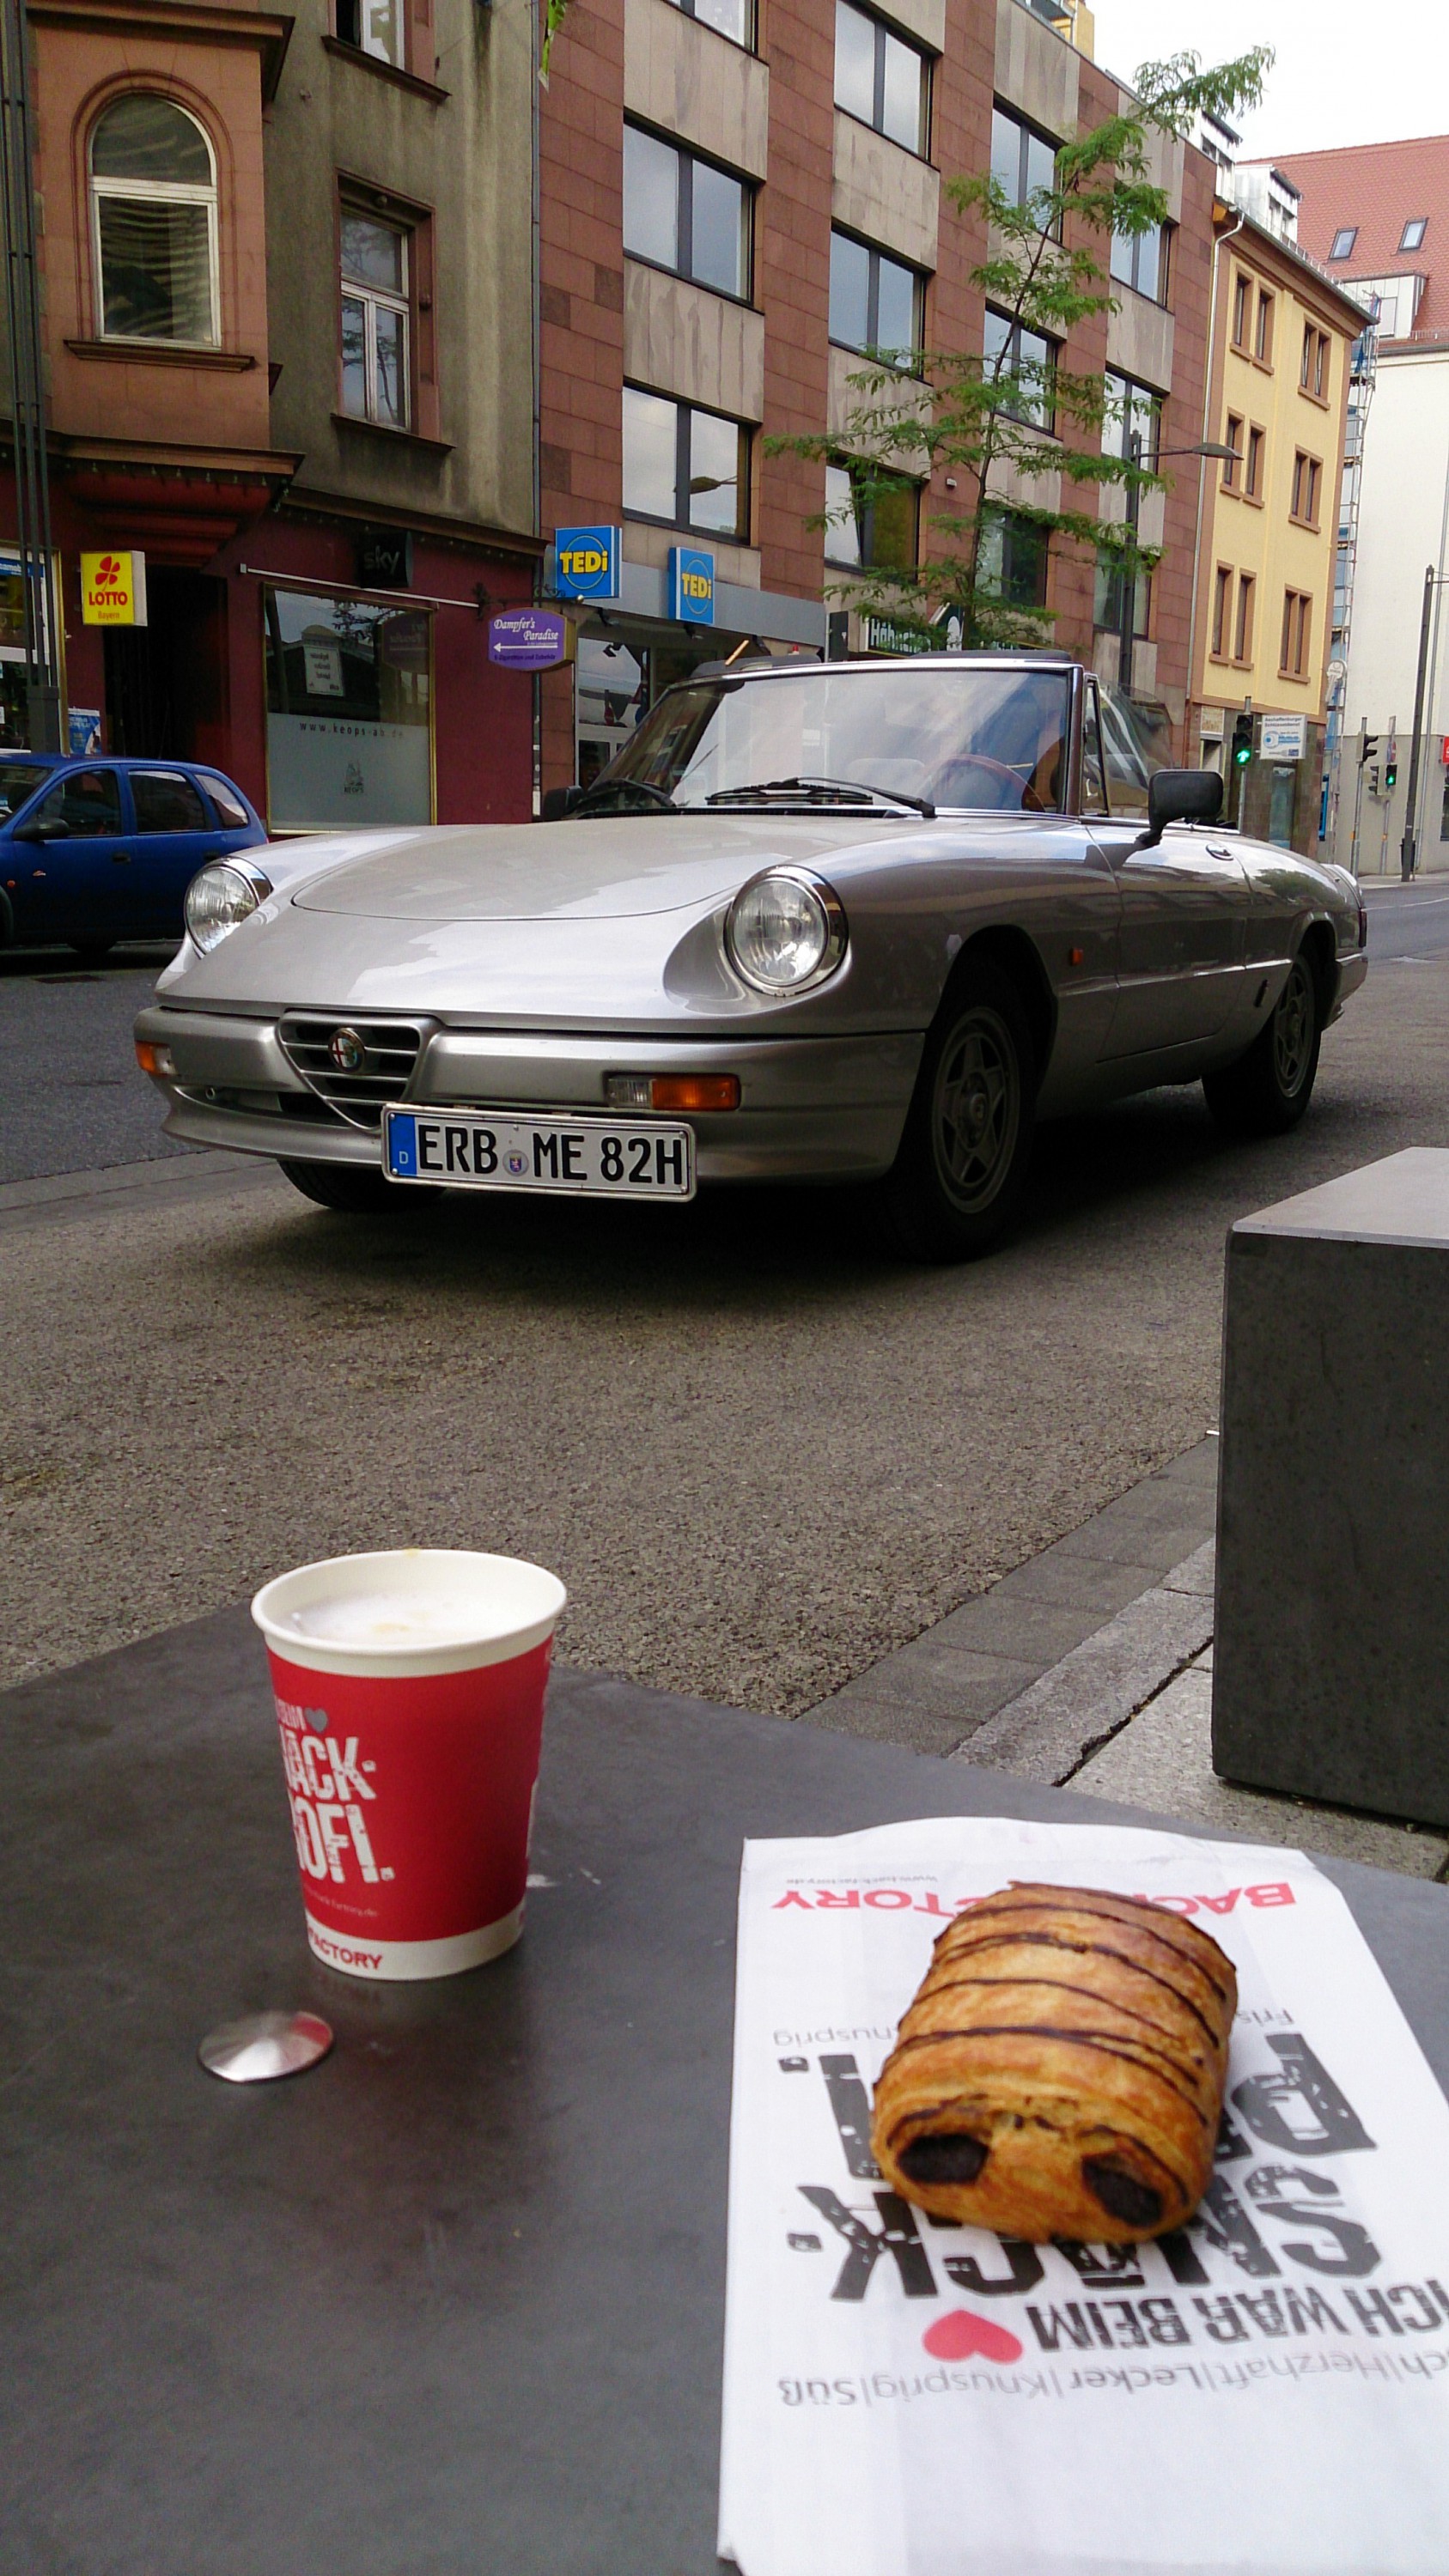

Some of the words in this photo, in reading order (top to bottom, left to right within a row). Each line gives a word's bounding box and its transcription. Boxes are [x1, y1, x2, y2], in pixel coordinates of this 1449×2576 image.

[364, 545, 400, 575] sky
[560, 550, 608, 574] TEDi
[88, 592, 128, 605] LOTTO
[681, 573, 712, 599] TEDi
[98, 611, 120, 620] Bayern
[494, 617, 535, 632] Dampfer's
[523, 629, 558, 641] Paradise
[399, 1151, 409, 1164] D
[418, 1124, 498, 1174] ERB
[533, 1133, 588, 1181] ME
[600, 1136, 683, 1185] 82H
[1132, 1882, 1297, 1917] BAC
[772, 2027, 900, 2049] nusprig
[1192, 2287, 1351, 2345] WAR
[1343, 2280, 1449, 2337] ICH
[1026, 2298, 1193, 2353] BEIM
